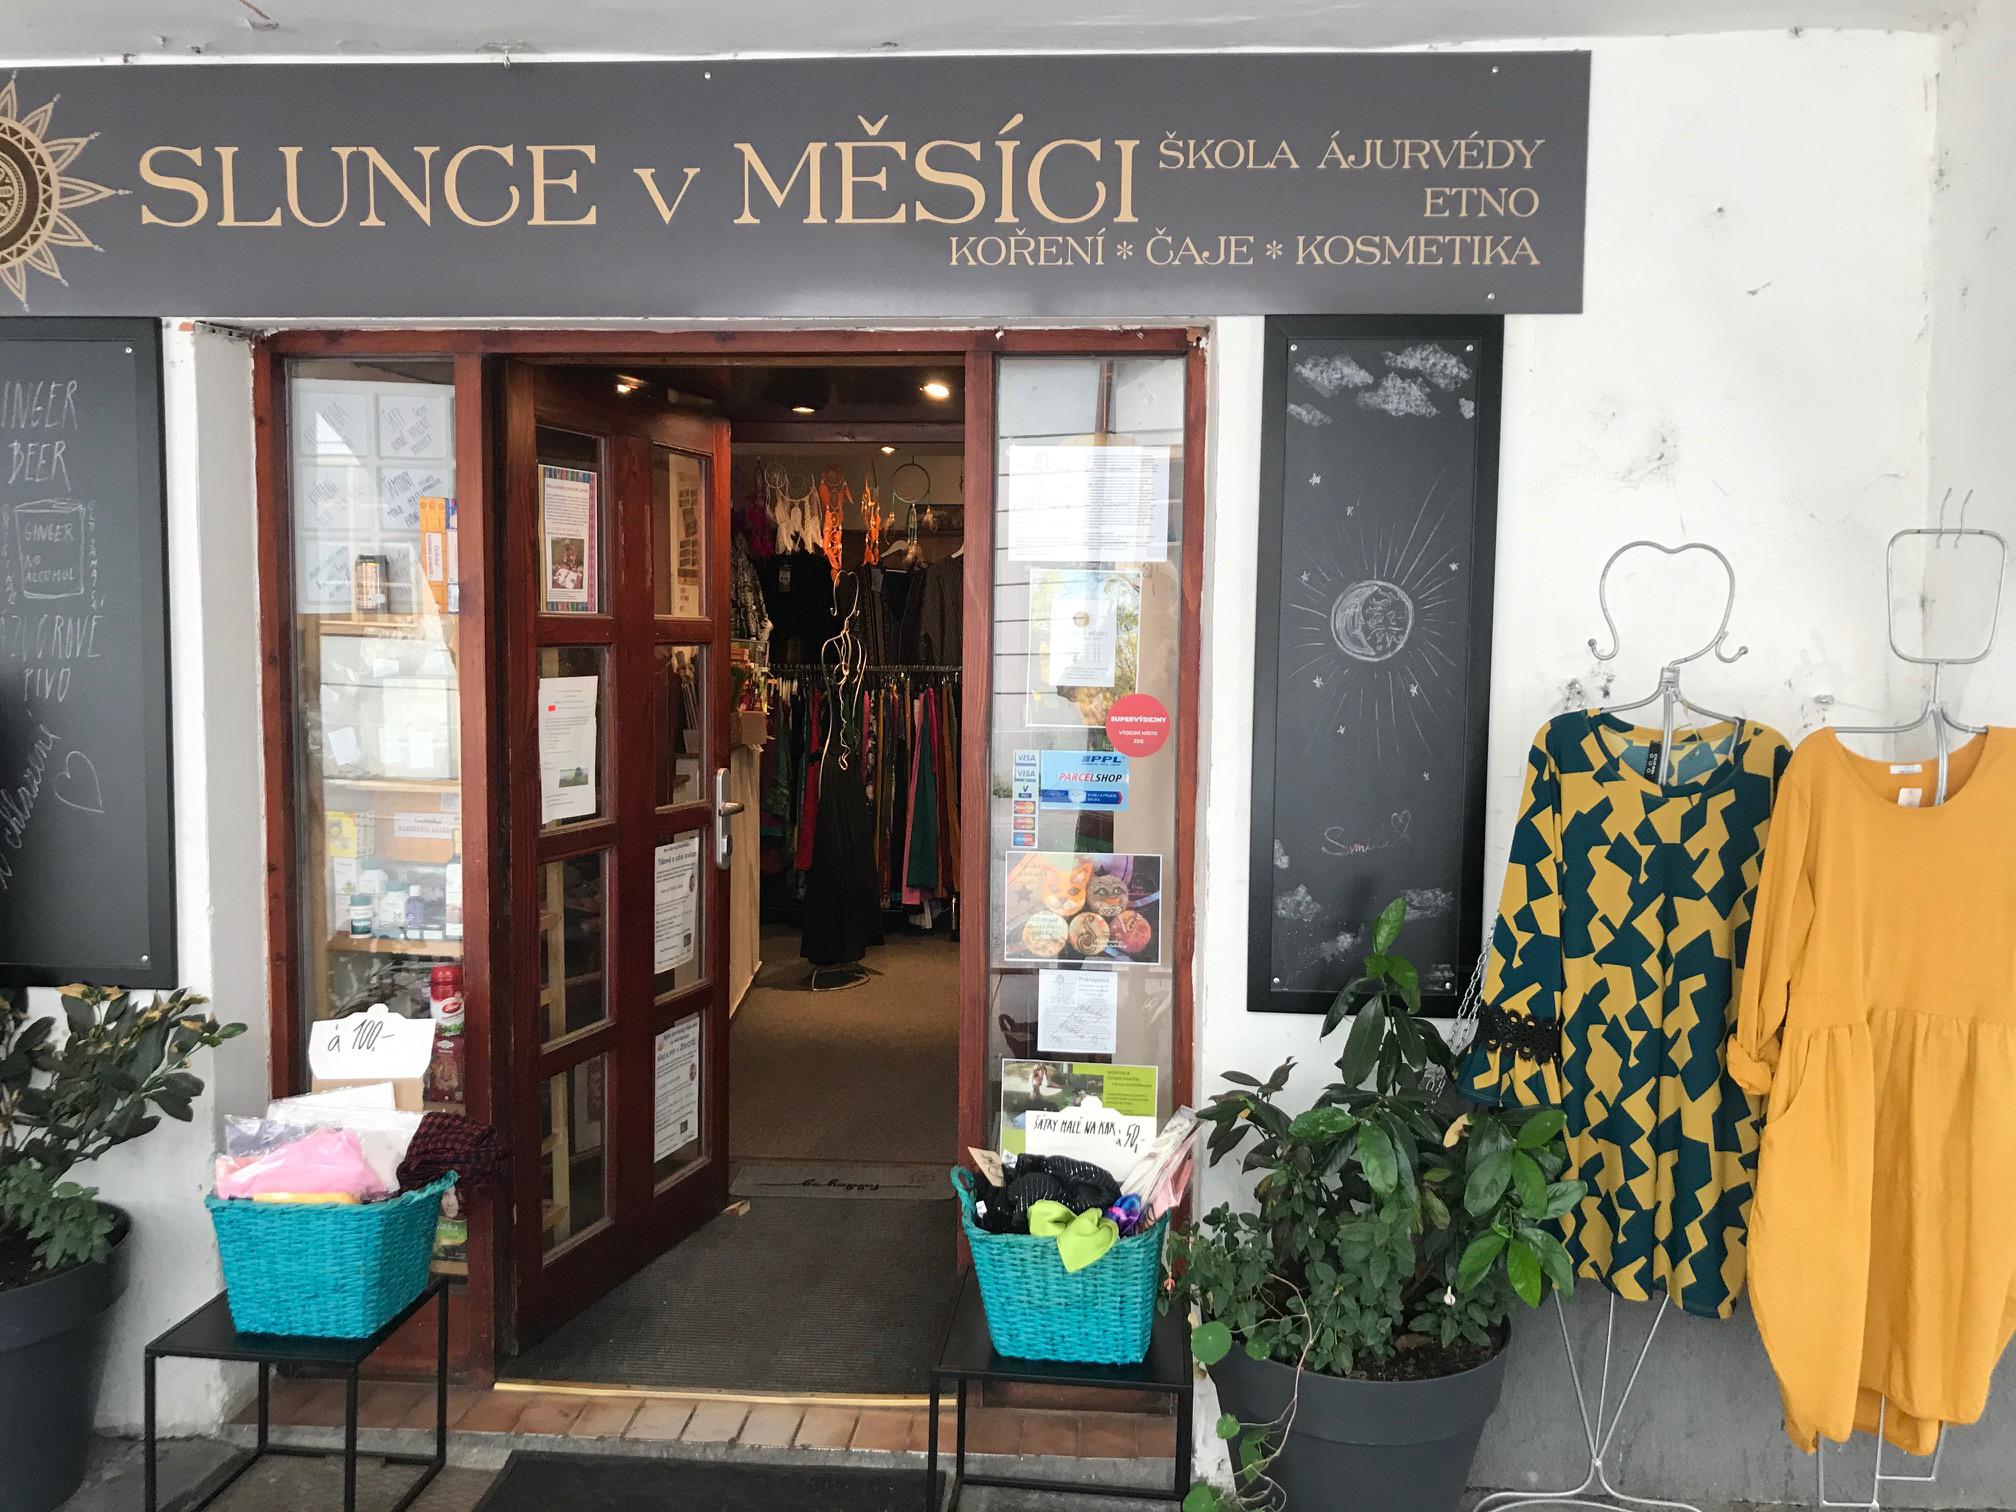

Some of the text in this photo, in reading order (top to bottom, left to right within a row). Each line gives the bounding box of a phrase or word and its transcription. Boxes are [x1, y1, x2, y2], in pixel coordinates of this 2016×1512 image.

[1158, 131, 1545, 171] ŠKOLA ÁJURVÉDY
[139, 114, 1140, 228] SLUNCE v MĚSÍCI
[1424, 186, 1540, 218] ETNO
[949, 227, 1541, 267] KOŘENÍ ČAJE KOSMETIKA
[1, 379, 80, 431] INGER
[7, 439, 71, 492] BEER
[25, 521, 74, 542] GINGER
[24, 667, 71, 702] PIVO
[1091, 755, 1122, 763] PPL
[1058, 772, 1123, 782] PARCELSHOP
[1084, 1120, 1097, 1135] NA
